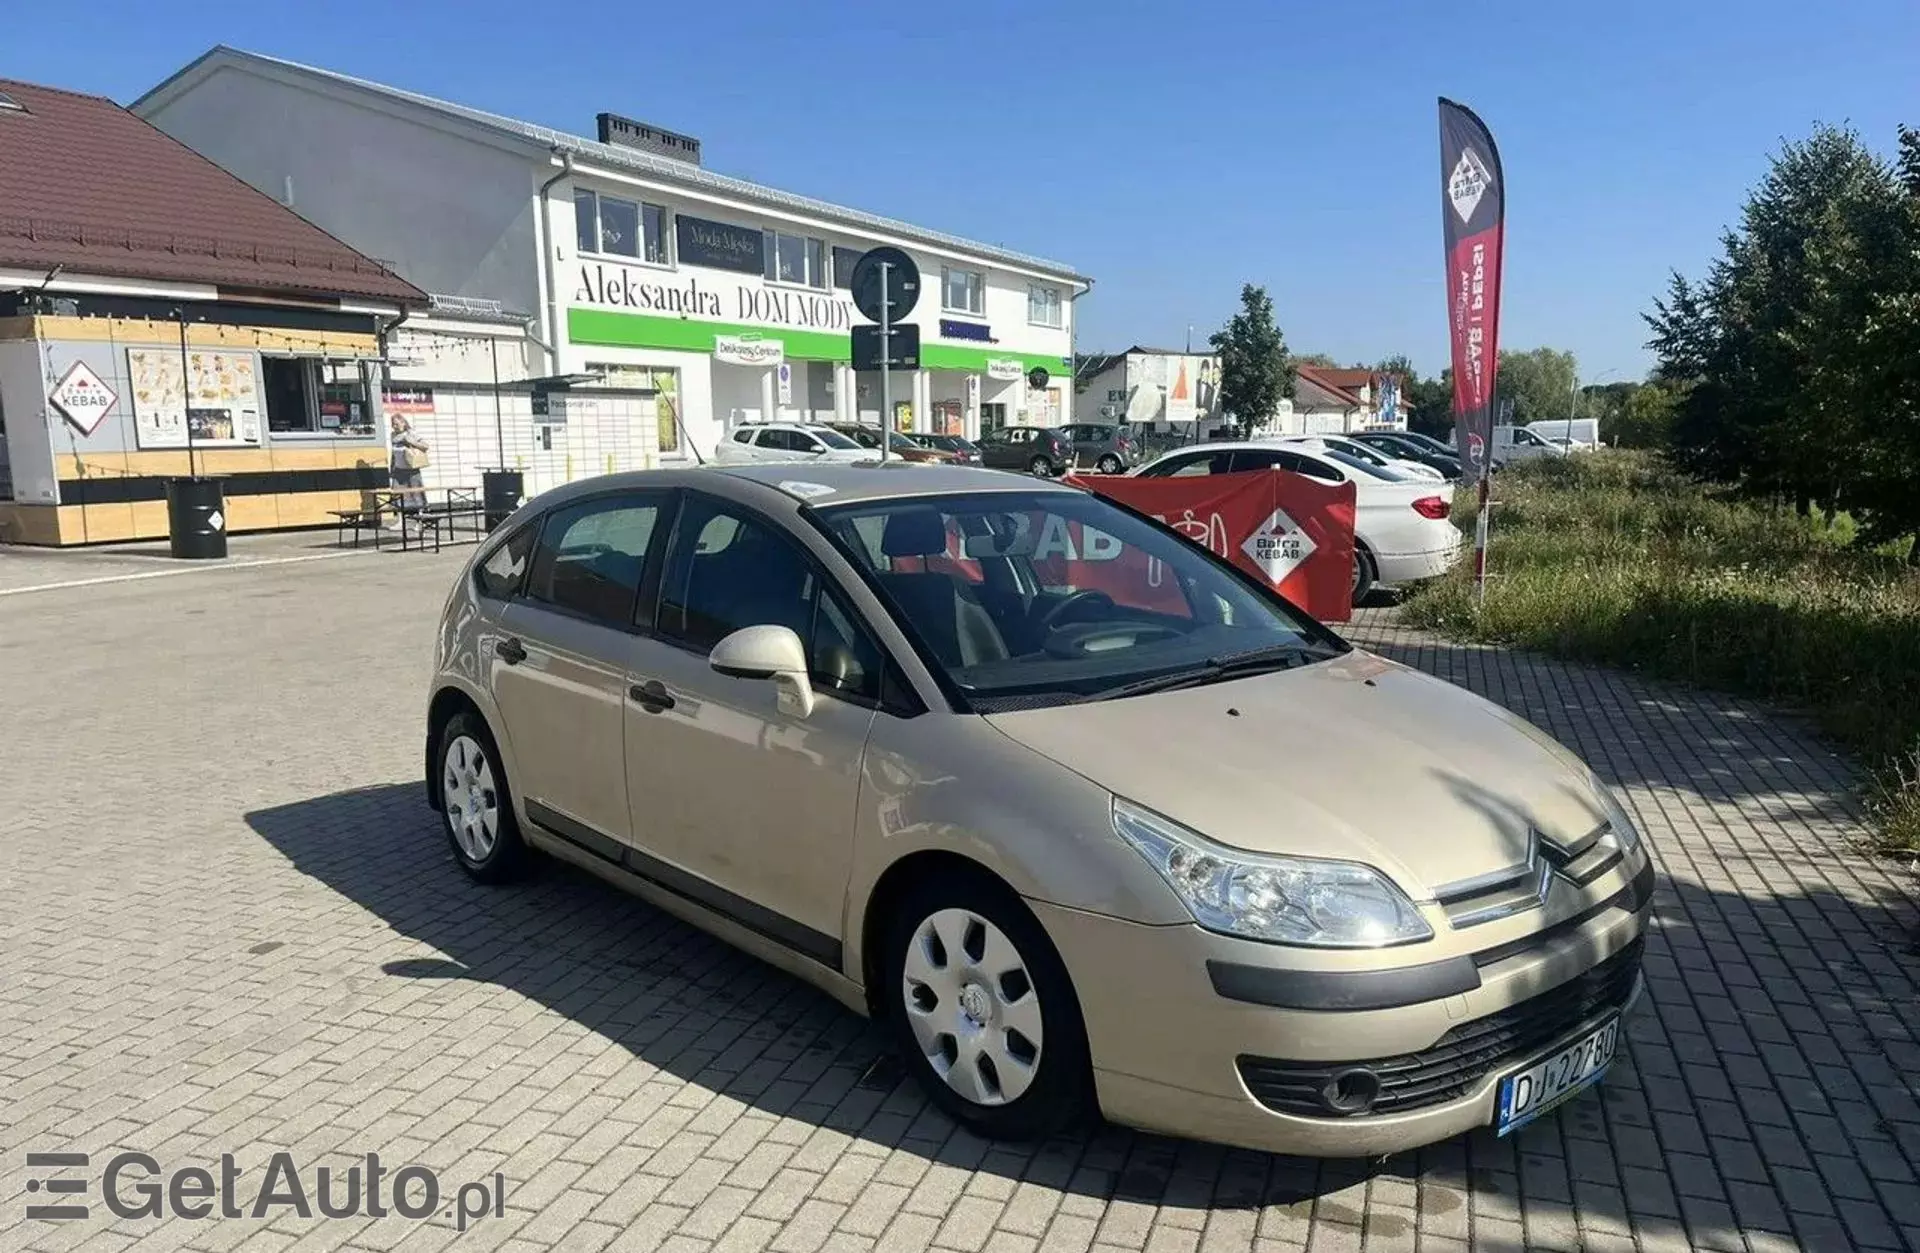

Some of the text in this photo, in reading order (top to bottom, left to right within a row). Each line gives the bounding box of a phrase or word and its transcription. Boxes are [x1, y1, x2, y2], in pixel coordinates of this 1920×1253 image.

[575, 264, 854, 331] Aleksandra DOM MODY
[63, 395, 108, 407] KEBAB
[1256, 538, 1300, 549] Bafra
[1256, 548, 1300, 560] KEBAB
[1556, 1022, 1616, 1092] 22780
